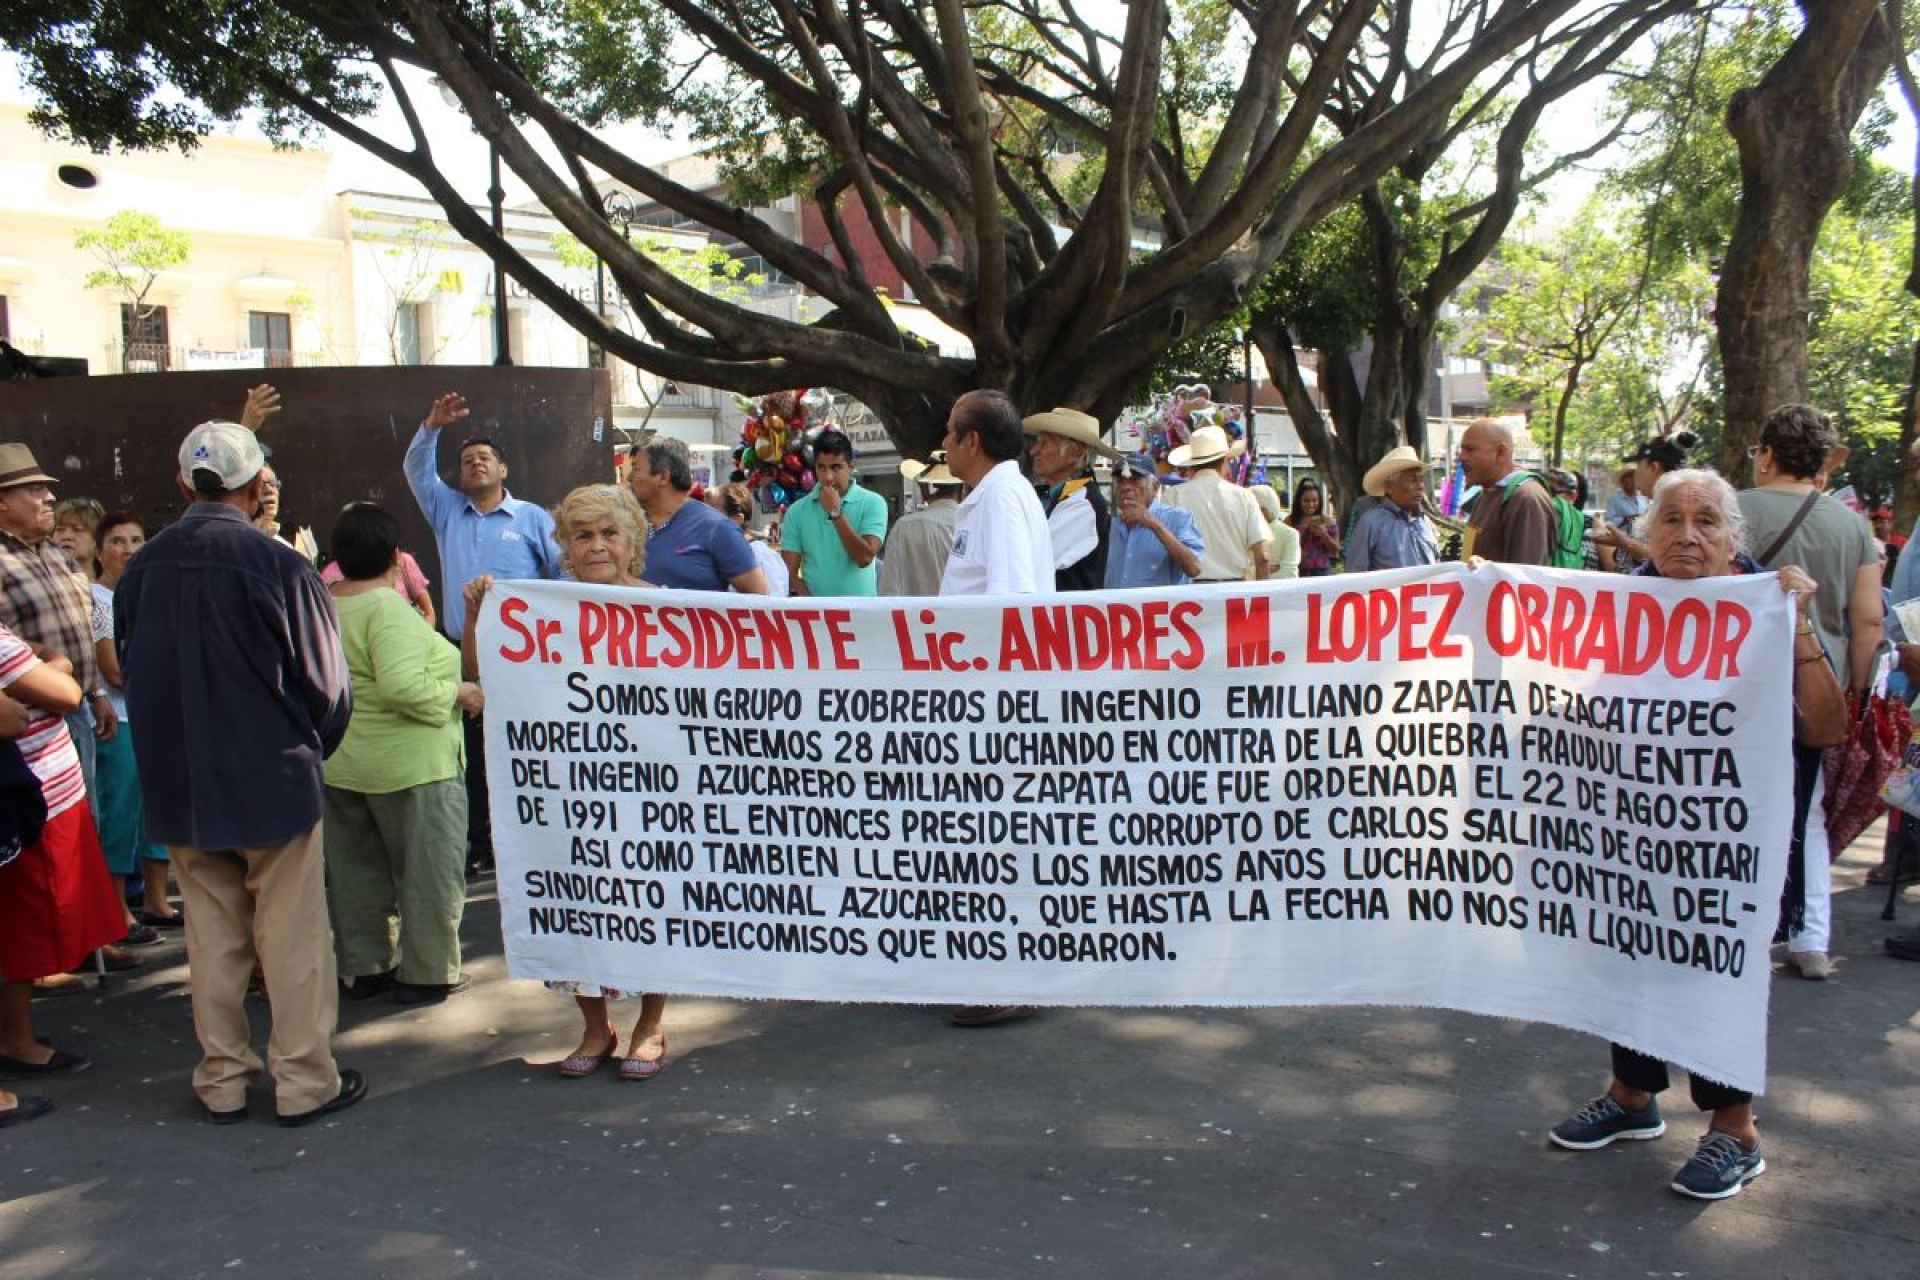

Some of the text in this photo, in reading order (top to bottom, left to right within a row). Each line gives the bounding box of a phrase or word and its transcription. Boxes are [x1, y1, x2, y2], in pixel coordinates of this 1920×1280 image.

[500, 581, 1751, 681] Sr. PRESIDENTE Lic. ANDRES M. LOPEZ OBRADOR
[675, 688, 707, 718] UN
[714, 688, 802, 720] GRUPO
[819, 689, 985, 723] EXOBREROS
[998, 690, 1048, 723] DEL
[1062, 688, 1200, 723] INGENIO
[1227, 685, 1382, 718] EMILIANO
[1392, 679, 1516, 714] ZAPATA
[1530, 682, 1558, 718] DE
[1562, 690, 1736, 736] ZACATEPEC
[507, 720, 1741, 789] MORELOS. TENEMOS 28 AÑOS LUCHANDO EN CONTRA DE LA QUIEBRA FRAUDULENTA
[512, 758, 1749, 832] DEL INGENIO AZUCARERO EMILIANO ZAPATA QUE FUE ORDENADA EL 22 DE AGOSTO
[517, 795, 1760, 883] DE 1991 POR EL ENTONCES PRESIDENTE CORRUPTO DE CARLOS SALINAS DE GORTARI
[571, 836, 611, 869] ASI
[621, 840, 693, 872] COMO
[702, 842, 838, 877] TAMBIEN
[854, 848, 1018, 885] LLEVAMOS
[1033, 853, 1089, 886] LOS
[1101, 853, 1222, 886] MISMOS
[1236, 848, 1326, 882] AÑOS
[1344, 848, 1513, 885] LUCHANDO
[1531, 858, 1658, 917] CONTRA
[525, 870, 664, 909] SINDICATO
[683, 881, 826, 916] NACIONAL
[1040, 895, 1096, 928] QUE
[1107, 891, 1211, 924] HASTA
[1229, 889, 1270, 921] LA
[1286, 888, 1389, 920] FECHA
[1408, 888, 1453, 921] NO
[1464, 891, 1528, 930] NOS
[1539, 901, 1578, 938] HA
[1589, 908, 1745, 978] LIQUIDADO
[529, 907, 1176, 963] NUESTROS FIDEICOMISOS QUE NOS ROBARON.
